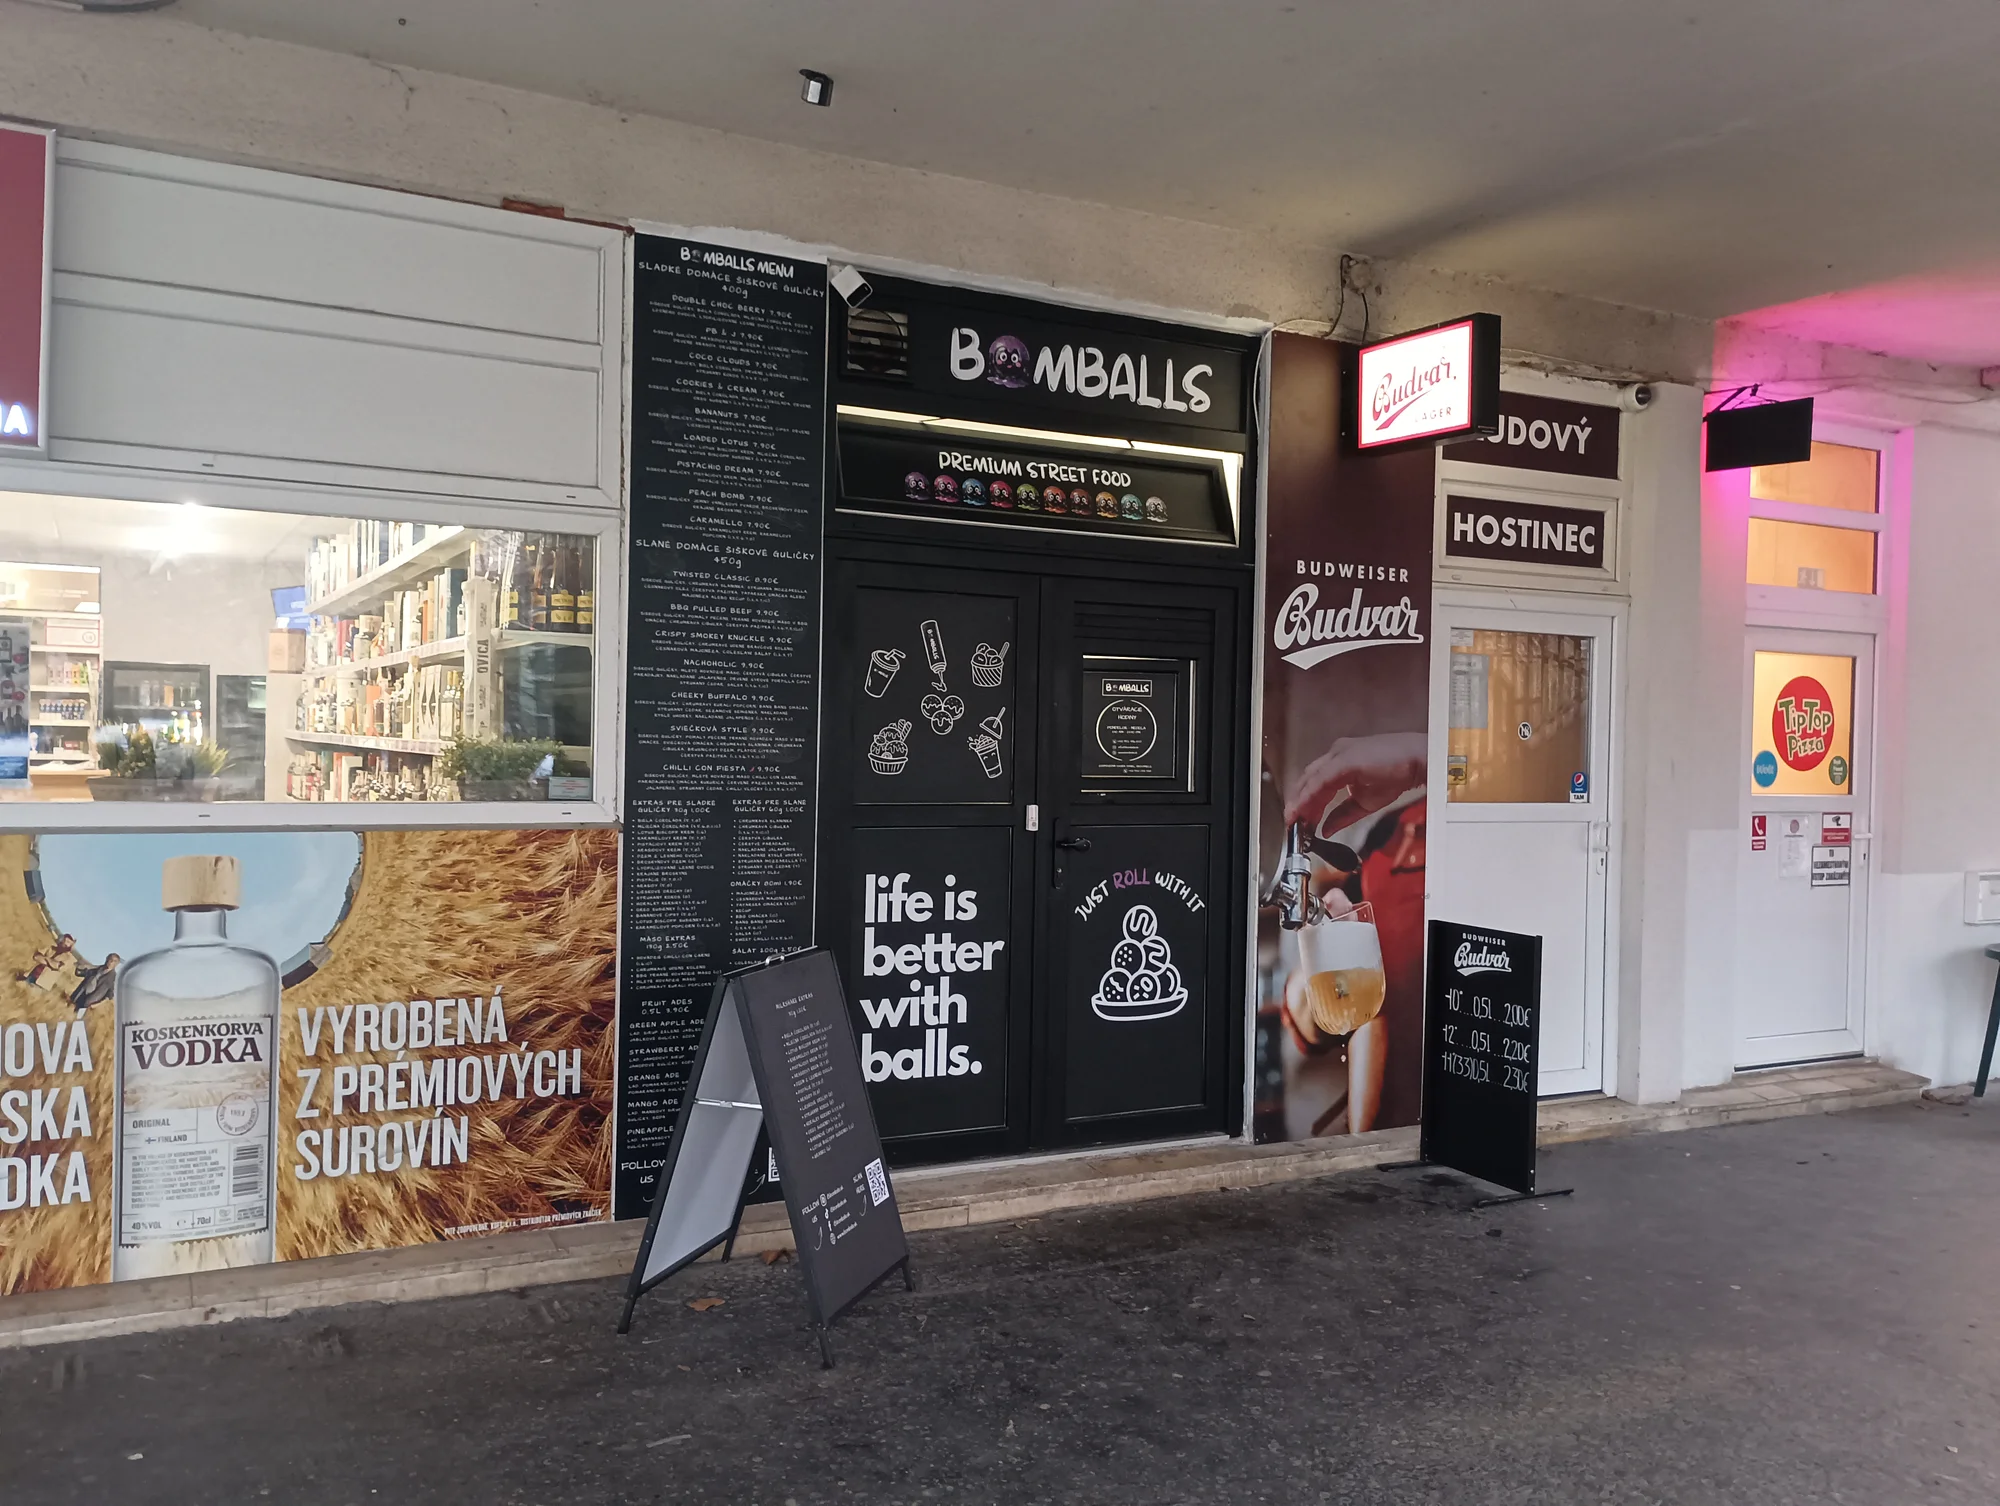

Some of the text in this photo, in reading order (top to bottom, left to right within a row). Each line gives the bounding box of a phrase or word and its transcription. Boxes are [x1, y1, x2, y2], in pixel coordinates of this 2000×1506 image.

[757, 261, 794, 278] MENU
[672, 294, 706, 306] DOUBLE
[711, 300, 733, 309] CHOC
[738, 304, 765, 314] BERRY
[689, 352, 712, 362] COCO
[717, 356, 750, 366] CLOUDS
[676, 378, 713, 389] COOKIES
[727, 384, 757, 394] CREAM
[0, 402, 28, 435] A
[695, 408, 739, 418] BANANUTS
[684, 434, 718, 443] LOADED
[721, 438, 749, 447] LOTUS
[1476, 415, 1593, 455] UDOVÝ
[677, 460, 721, 471] PISTACHIO
[725, 465, 753, 474] DREAM
[938, 452, 1131, 488] PREMIUM STREET FOOD
[689, 489, 717, 498] PEACH
[721, 491, 745, 500] BOMB
[690, 516, 743, 527] CARAMELLO
[1453, 512, 1595, 554] HOSTINEC
[714, 556, 742, 569] 450g
[1296, 559, 1409, 583] BUDWEISER
[673, 571, 710, 579] TWISTED
[715, 574, 750, 582] CLASSIC
[693, 605, 726, 613] PULLED
[730, 607, 752, 615] BEEF
[1274, 583, 1424, 652] Budvar
[655, 630, 686, 638] CRISPY
[690, 632, 724, 640] SMOKEY
[728, 633, 765, 642] KNUCKLE
[684, 659, 737, 667] NACHOHOLIC
[708, 693, 748, 701] BUFFALO
[671, 725, 717, 733] SVIEČKOVÁ
[1788, 734, 1824, 760] Pizza
[864, 872, 978, 923] life is
[1074, 868, 1206, 922] JUST ROLL WITH IT
[1462, 932, 1506, 946] BUDWEISER
[864, 927, 1005, 977] better
[1454, 942, 1512, 972] Budvar
[859, 976, 968, 1029] with
[297, 985, 508, 1057] VYROBENÁ
[132, 1022, 264, 1043] KOSKENKORVA
[0, 1008, 93, 1078] OVÁ
[629, 1046, 685, 1055] STRAWBERRY
[132, 1036, 263, 1070] VODKA
[861, 1028, 982, 1082] balls.
[295, 1041, 581, 1119] Z PRÉMIOVÝCH
[628, 1100, 658, 1108] MANGO
[132, 1118, 171, 1129] ORIGINAL
[627, 1126, 674, 1135] PINEAPPLE
[157, 1134, 188, 1144] FINLAND
[294, 1106, 469, 1181] SUROVÍN
[640, 1175, 654, 1183] US
[802, 1199, 820, 1216] FOLLOW
